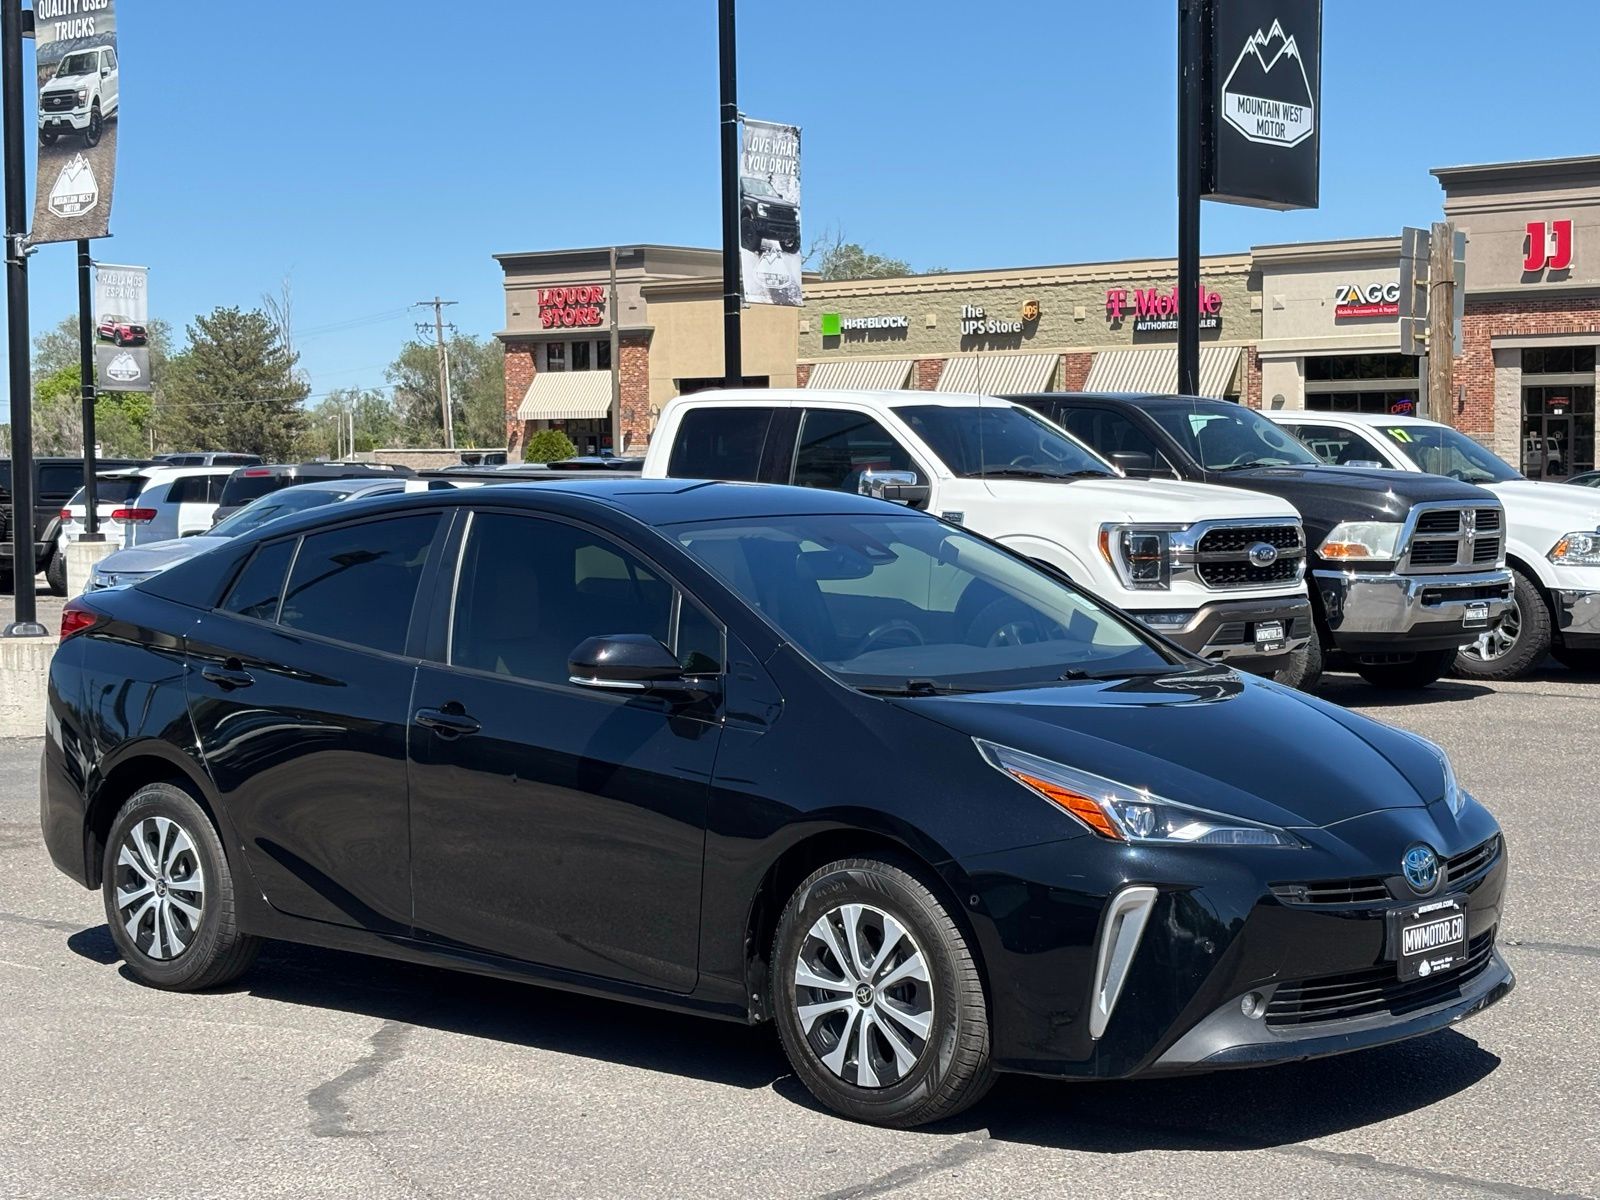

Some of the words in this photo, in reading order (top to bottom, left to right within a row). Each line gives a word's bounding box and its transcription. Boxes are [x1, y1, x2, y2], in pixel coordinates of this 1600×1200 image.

[38, 0, 79, 20] QUALITY
[54, 16, 95, 41] TRUCKS
[1237, 96, 1281, 120] MOUNTAIN
[1282, 104, 1303, 124] WEST
[1256, 119, 1286, 139] MOTOR
[747, 136, 770, 153] LOVE
[771, 138, 797, 157] WHAT
[748, 155, 767, 172] YOU
[769, 158, 797, 176] DRIVE
[1523, 219, 1574, 272] JJ
[537, 286, 605, 308] LIQUOR
[1133, 284, 1222, 316] Mole
[1335, 282, 1400, 305] ZAGG
[541, 307, 601, 327] STORE
[960, 304, 984, 319] The
[867, 316, 907, 329] BLOCK
[960, 320, 986, 336] UPS
[986, 319, 1021, 334] Store
[1136, 320, 1179, 331] AUTHORIZE
[1405, 918, 1462, 952] MWMOTOR.CO
